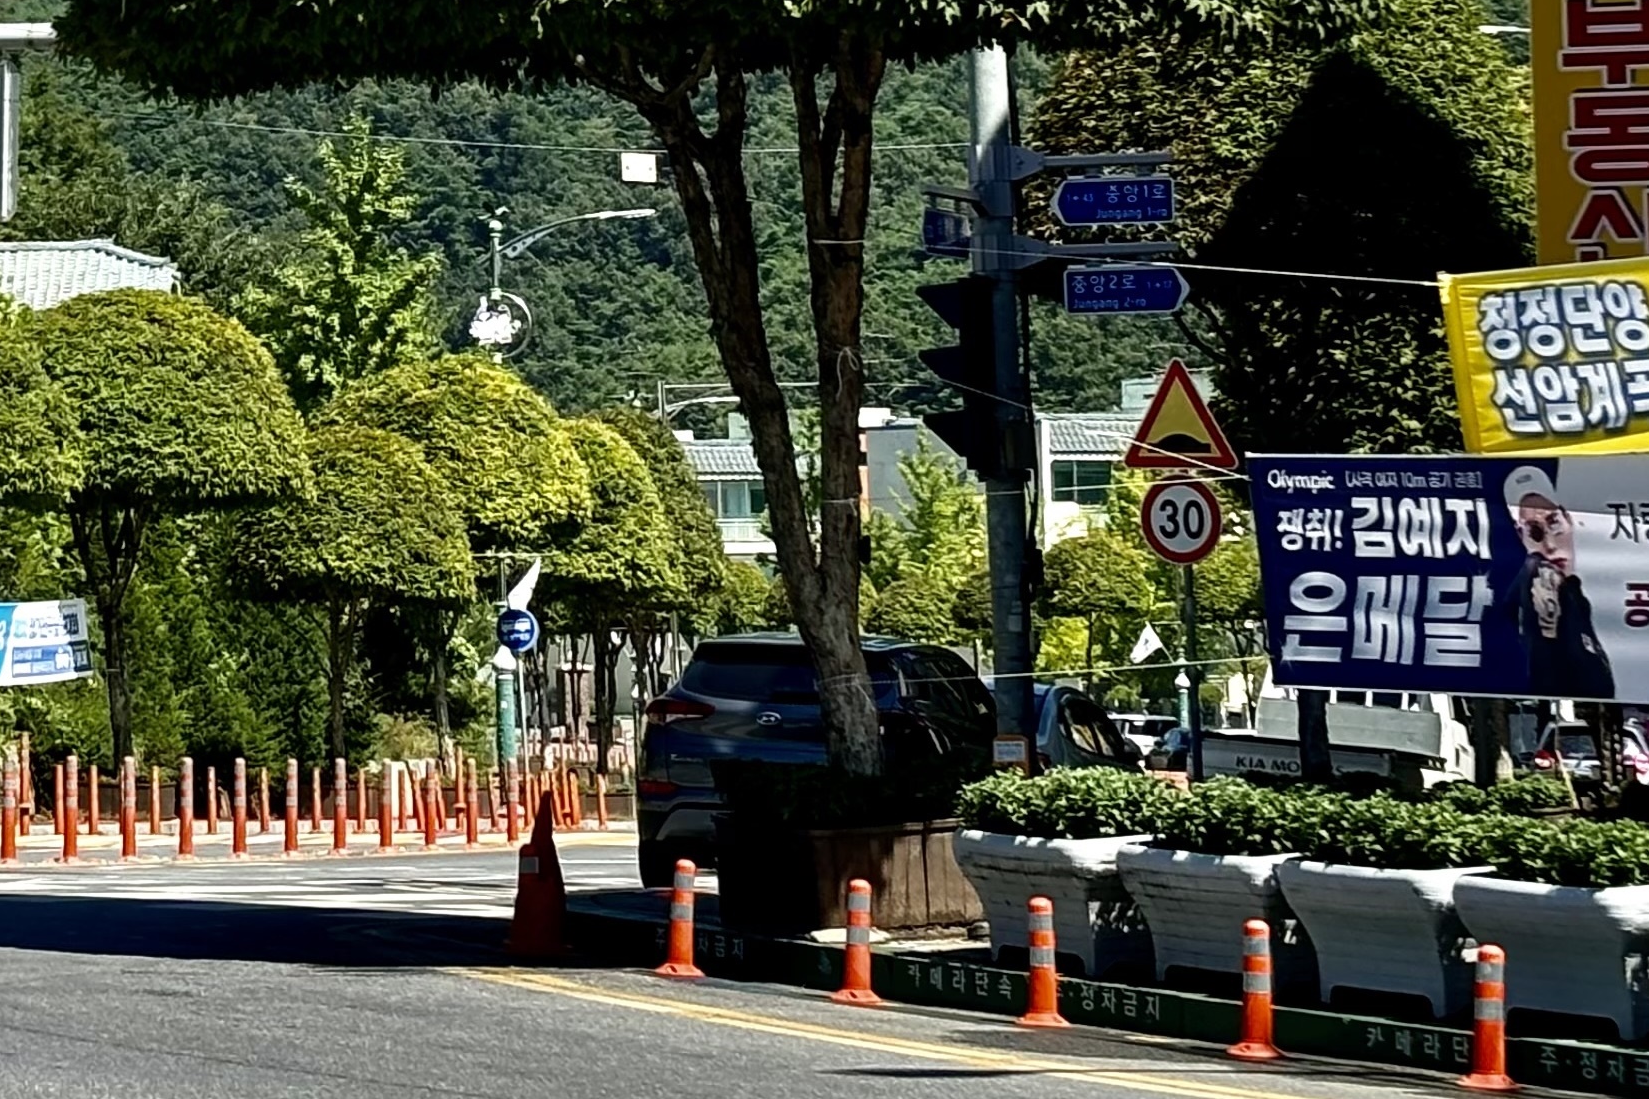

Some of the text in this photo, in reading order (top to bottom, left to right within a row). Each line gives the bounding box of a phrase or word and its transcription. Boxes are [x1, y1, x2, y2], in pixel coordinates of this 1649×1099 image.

[1106, 184, 1167, 204] 중앙1로
[1096, 208, 1142, 220] Jungang
[1072, 274, 1136, 294] 중앙2로
[1073, 298, 1119, 310] Jungang
[1479, 282, 1649, 360] 청정단양
[1267, 470, 1335, 494] Olympic
[1375, 471, 1398, 488] 여자
[1400, 471, 1427, 488] 10m
[1159, 498, 1204, 540] 30
[1277, 497, 1492, 560] 쟁취! 김예지
[1282, 571, 1494, 668] 은메달
[1235, 756, 1266, 770] KIA
[908, 964, 1012, 1000] 카메라단속
[1366, 1026, 1469, 1064] 카메라단
